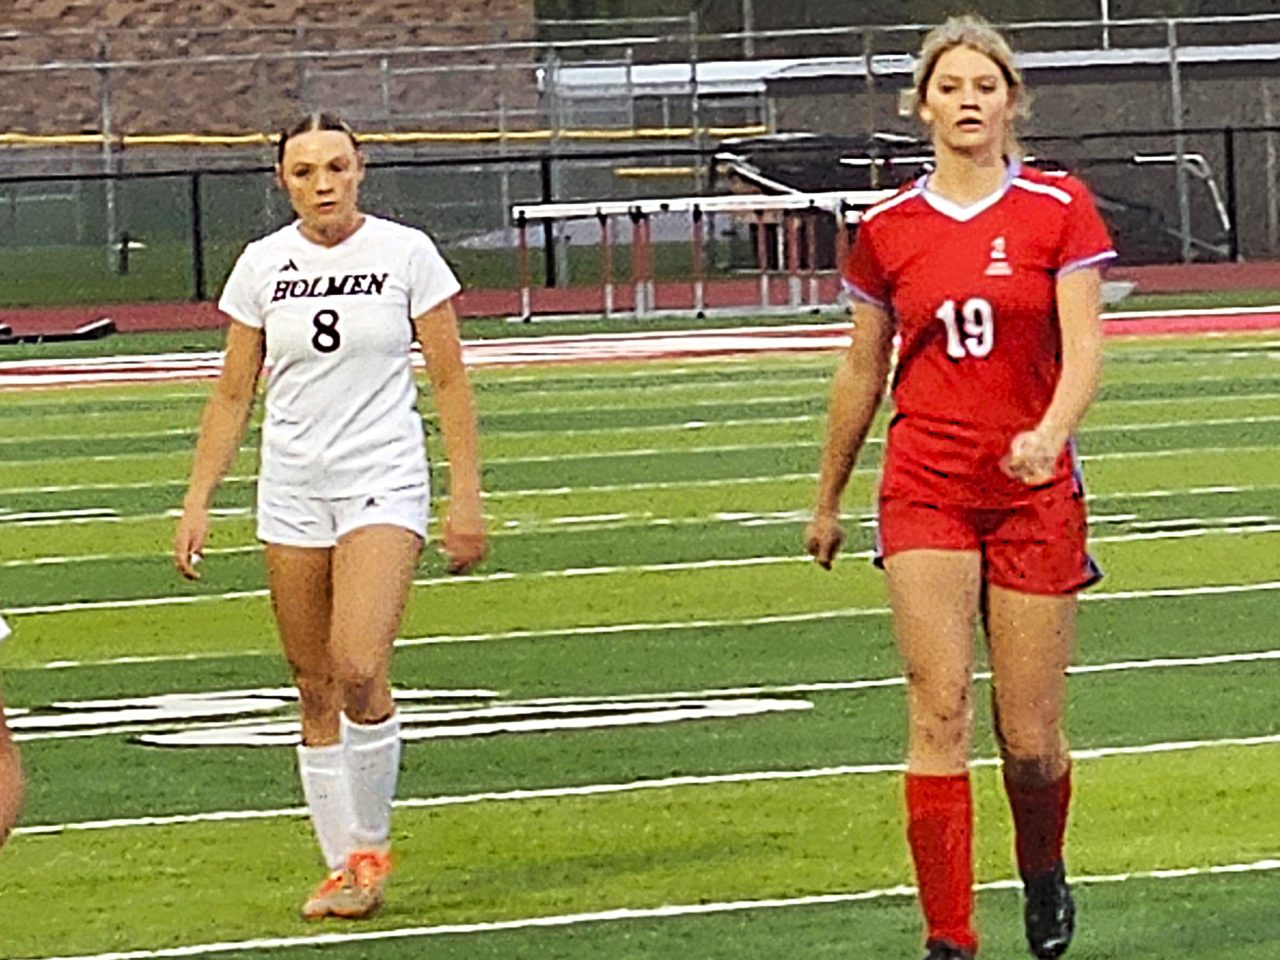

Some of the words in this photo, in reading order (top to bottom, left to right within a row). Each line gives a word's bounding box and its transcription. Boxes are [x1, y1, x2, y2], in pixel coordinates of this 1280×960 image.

[271, 273, 388, 302] HOLMEN
[311, 309, 341, 353] 8
[936, 298, 994, 358] 19
